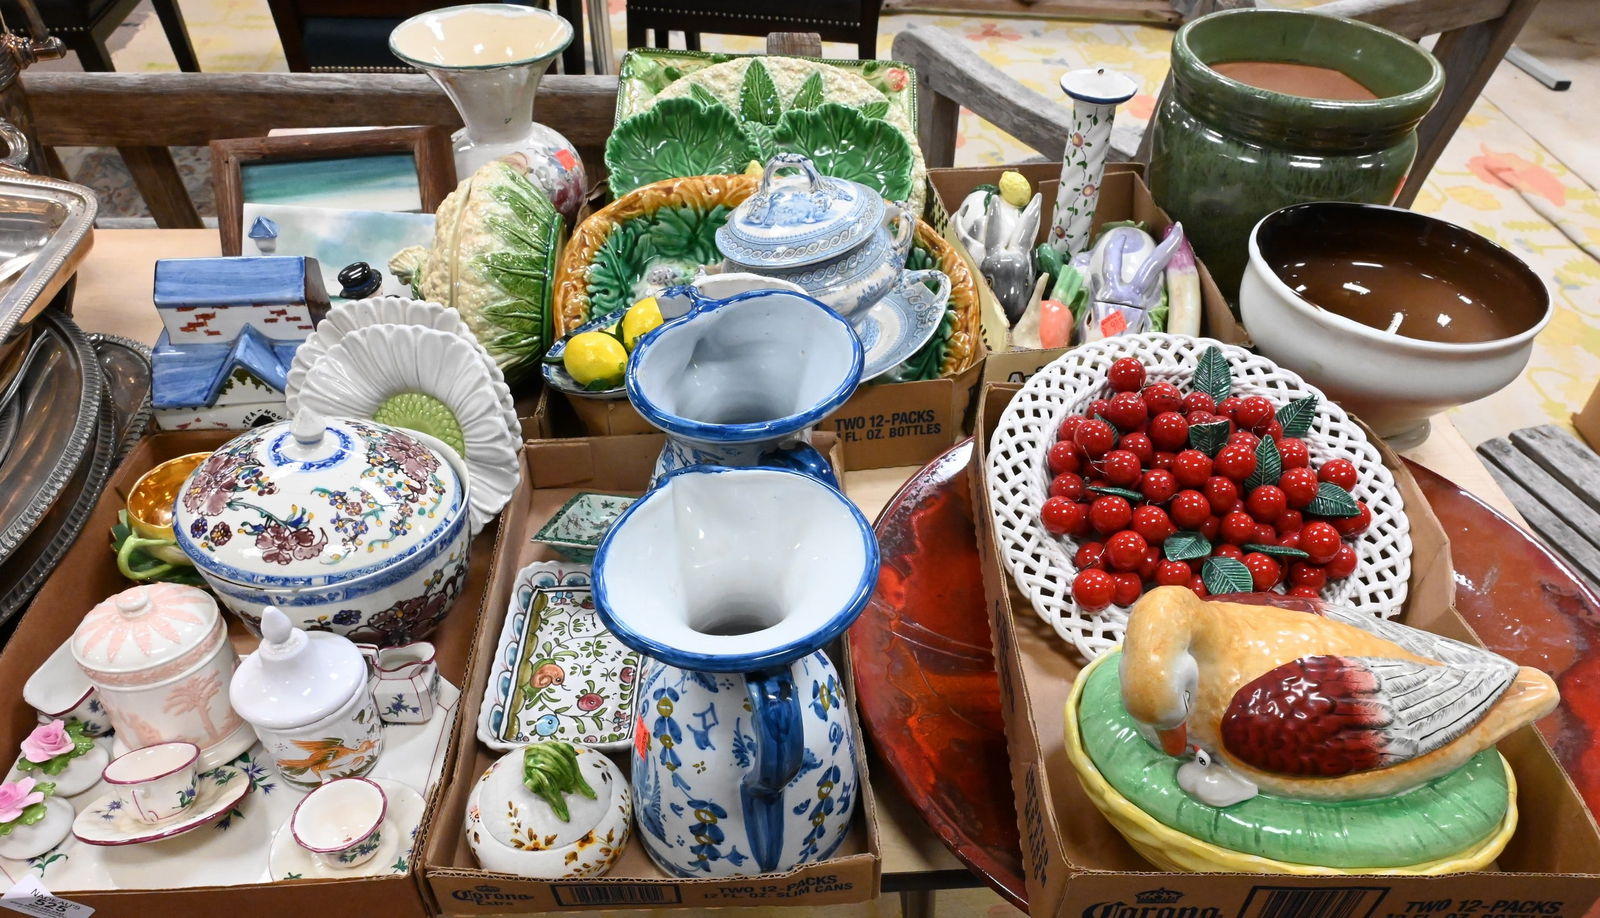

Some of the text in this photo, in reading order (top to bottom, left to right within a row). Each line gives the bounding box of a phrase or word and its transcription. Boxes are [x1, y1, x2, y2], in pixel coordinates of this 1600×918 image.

[834, 410, 936, 432] TWO 12-PACKS
[845, 431, 862, 443] FL.
[866, 429, 885, 441] OZ.
[889, 423, 942, 438] BOTTLES
[719, 875, 839, 894] TWO 12-PACKS
[777, 887, 810, 898] SLIM
[815, 882, 854, 894] CANS
[452, 889, 535, 901] Corona
[474, 898, 514, 906] Extra
[34, 898, 67, 912] 525
[1404, 899, 1565, 914] TWO 12-PACKS
